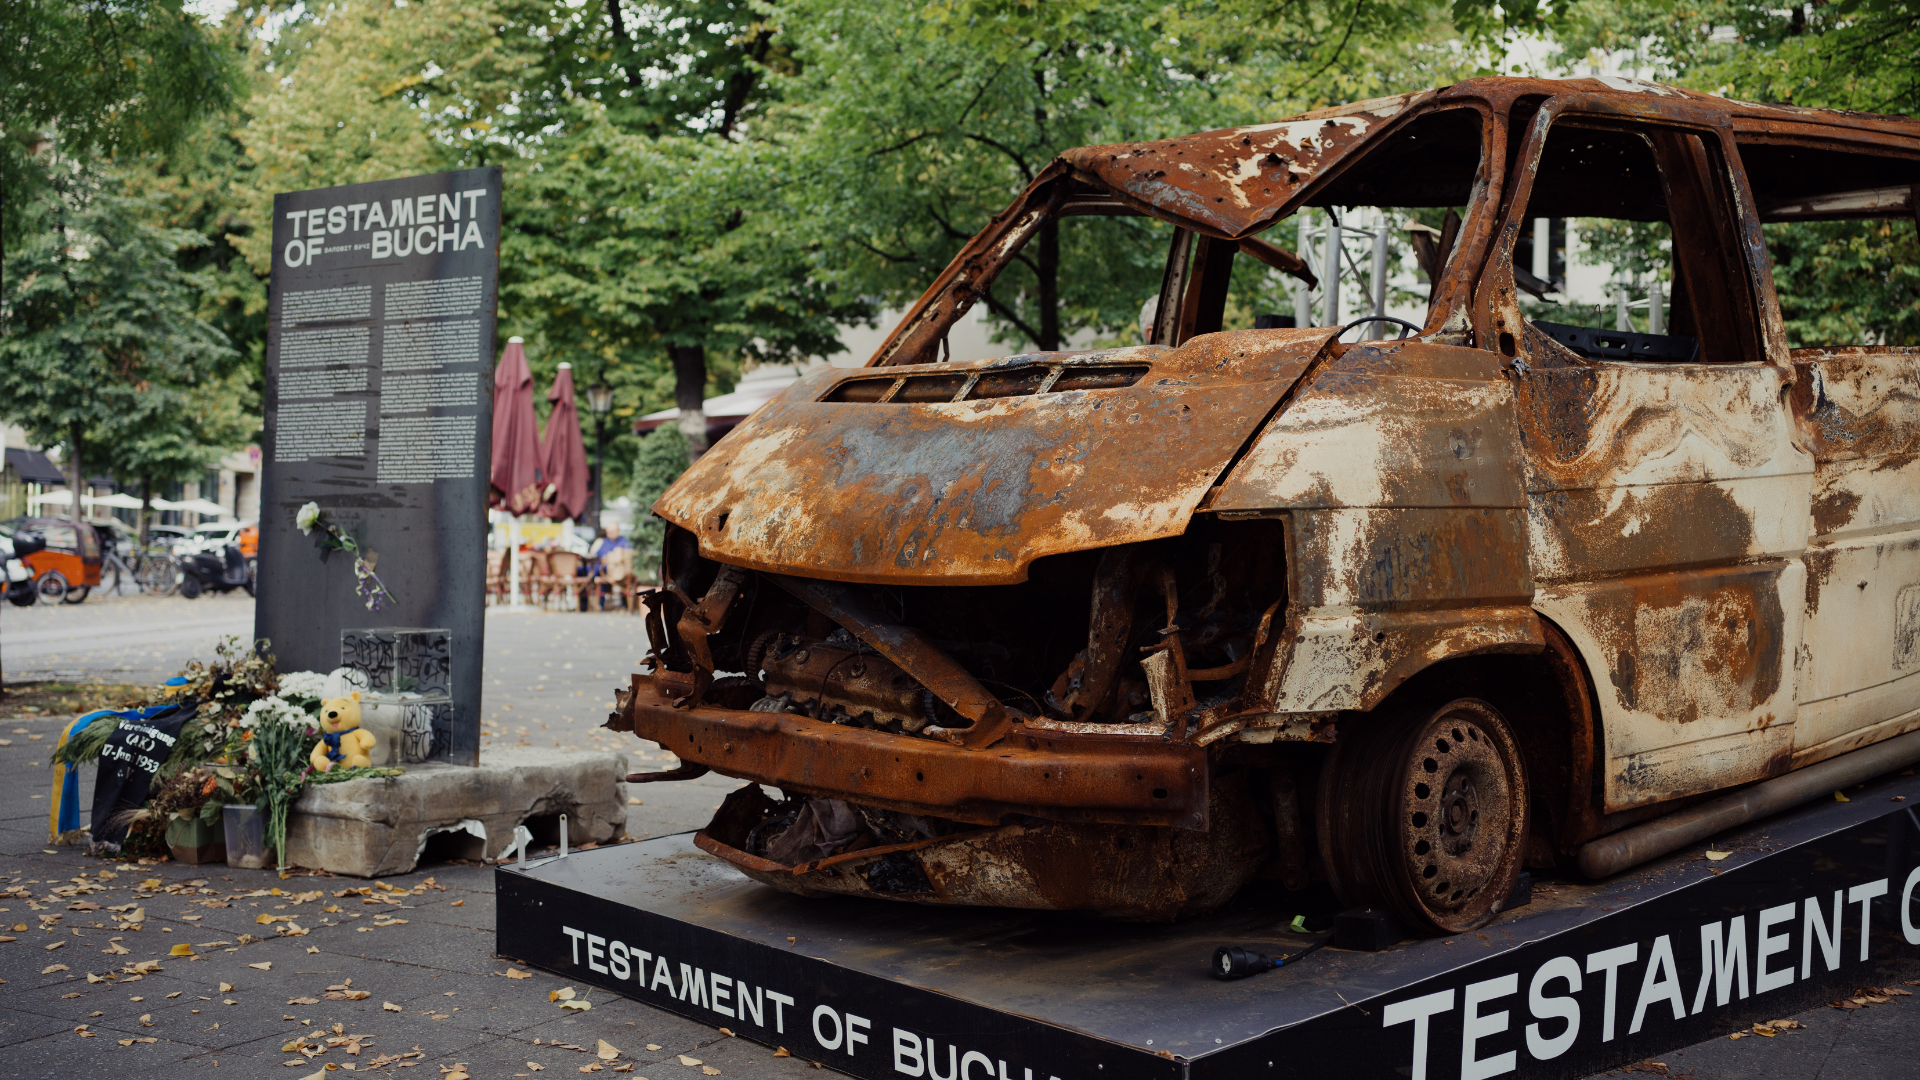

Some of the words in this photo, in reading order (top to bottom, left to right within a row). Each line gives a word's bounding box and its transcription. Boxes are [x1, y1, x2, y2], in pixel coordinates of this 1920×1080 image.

[286, 188, 487, 238] TESTAMENT
[284, 237, 325, 268] OF
[371, 221, 485, 260] BUCHA
[119, 720, 177, 747] Vereinigung
[126, 733, 156, 752] (AK)
[135, 754, 160, 773] 1953
[1382, 877, 1889, 1080] TESTAMENT
[562, 925, 795, 1035] TESTAMENT
[812, 1003, 871, 1056] OF
[892, 1026, 1062, 1080] BUC
